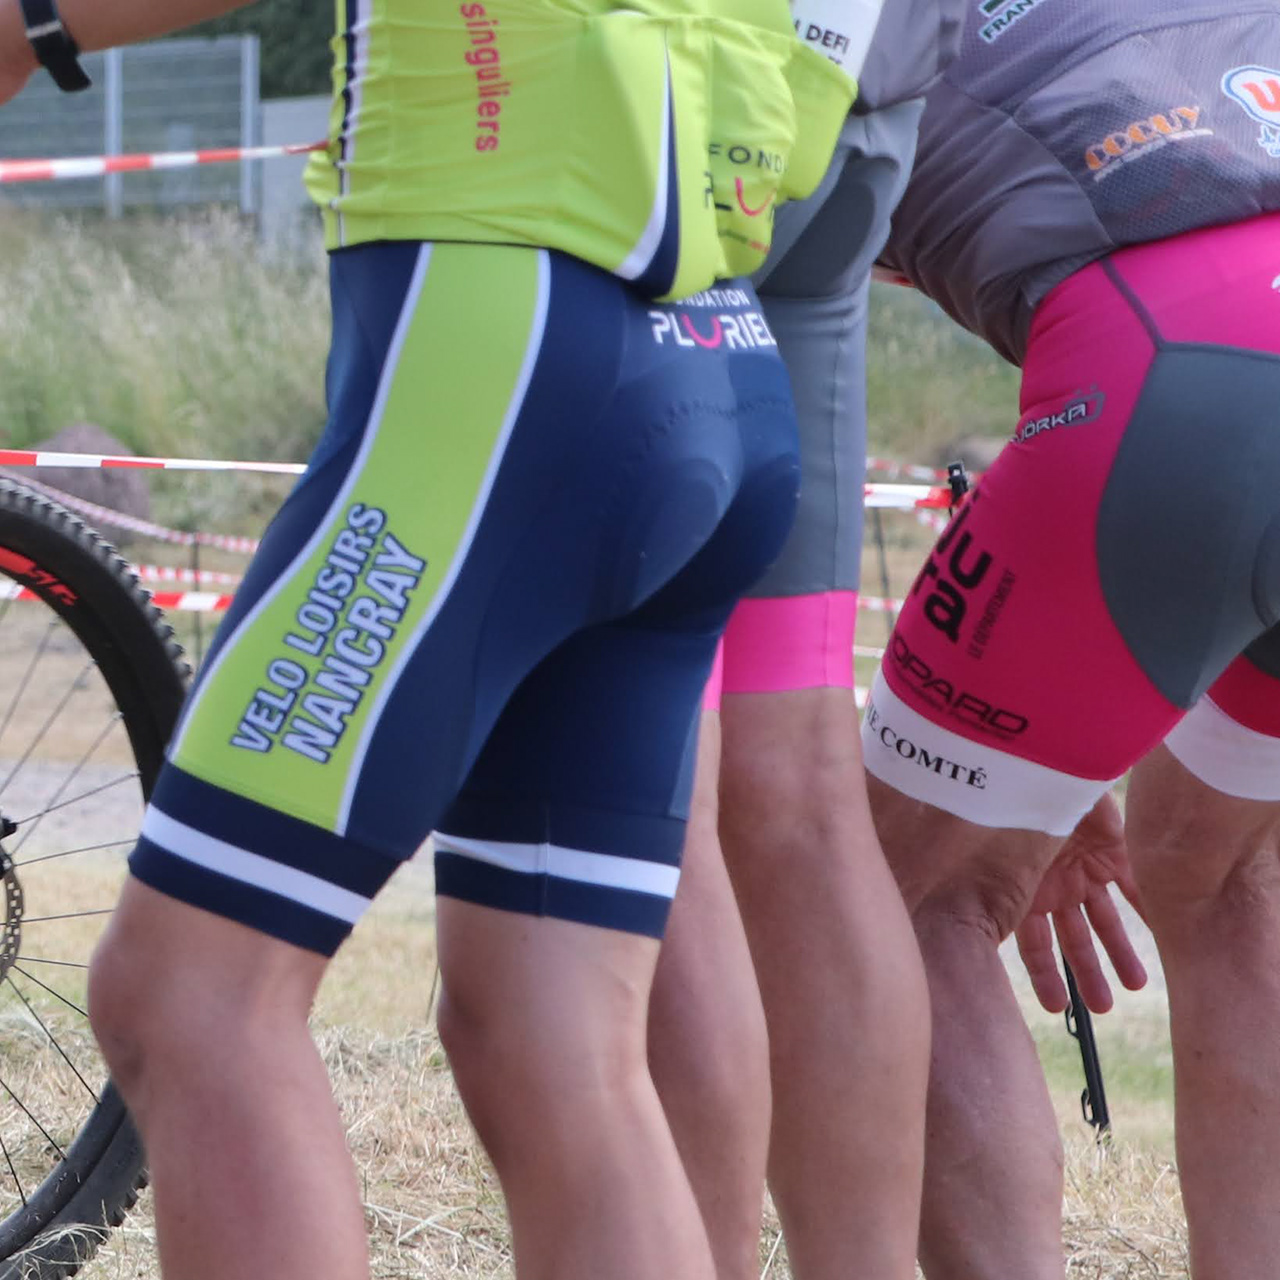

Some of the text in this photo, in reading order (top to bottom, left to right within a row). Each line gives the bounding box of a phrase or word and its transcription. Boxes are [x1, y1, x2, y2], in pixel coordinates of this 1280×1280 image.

[461, 1, 512, 152] singuliers
[647, 310, 777, 350] PLURIEL
[229, 502, 387, 754] VELO LOISIRS
[281, 531, 428, 765] NANCRAY
[880, 725, 988, 791] COMTÉ
